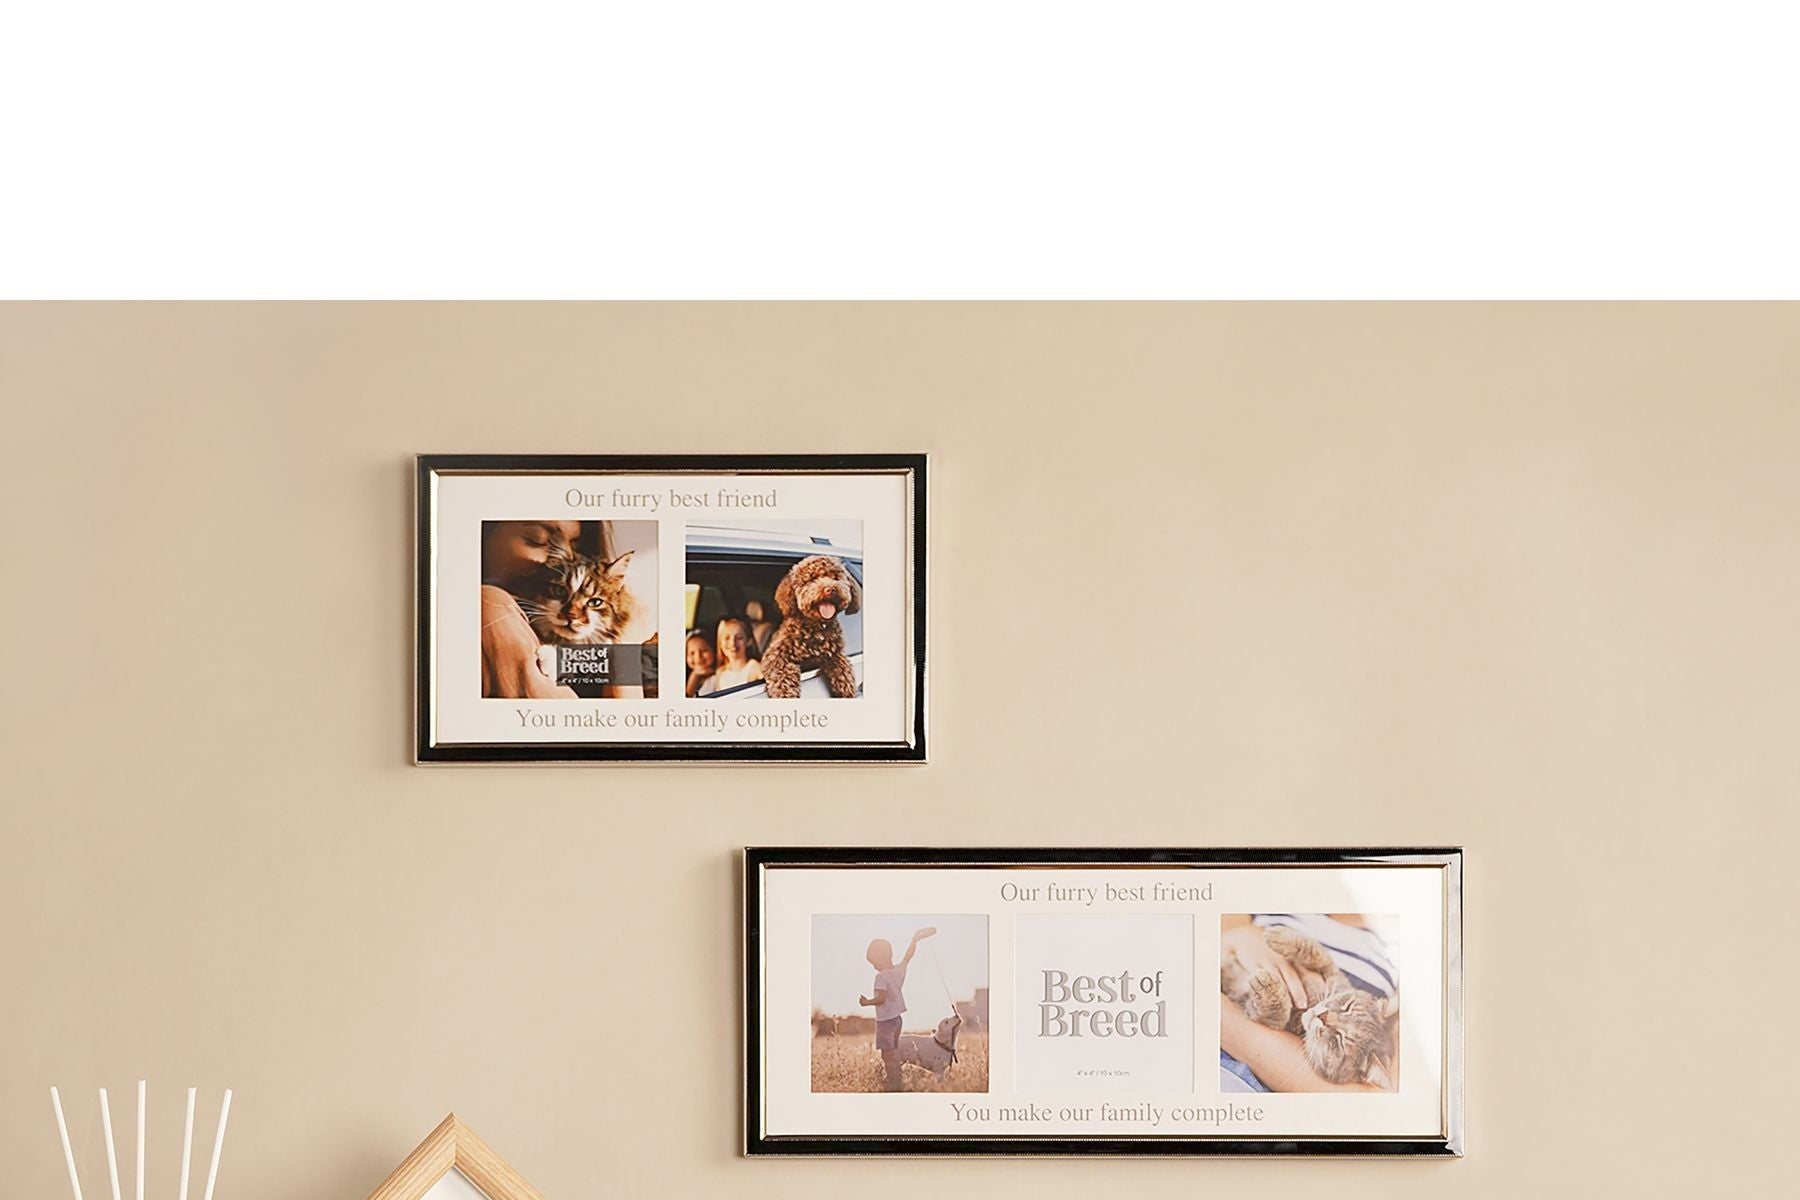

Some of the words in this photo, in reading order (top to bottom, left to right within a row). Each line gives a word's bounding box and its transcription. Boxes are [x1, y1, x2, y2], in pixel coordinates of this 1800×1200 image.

[566, 489, 604, 507] Our
[613, 489, 662, 512] furry
[670, 489, 708, 507] best
[718, 489, 776, 507] friend
[561, 648, 598, 661] Best
[597, 648, 608, 658] of
[561, 660, 609, 674] Breed
[516, 709, 555, 727] You
[564, 709, 616, 727] make
[625, 715, 658, 727] our
[666, 709, 728, 732] family
[736, 710, 828, 732] complete
[1001, 883, 1040, 901] Our
[1048, 883, 1097, 906] furry
[1106, 883, 1144, 901] best
[1154, 882, 1212, 901] friend
[1041, 970, 1136, 1003] Best
[1139, 971, 1163, 997] of
[1038, 1000, 1168, 1037] Breed
[951, 1104, 990, 1121] You
[1000, 1103, 1052, 1121] make
[1060, 1109, 1093, 1121] our
[1102, 1103, 1163, 1126] family
[1171, 1103, 1263, 1126] complete
